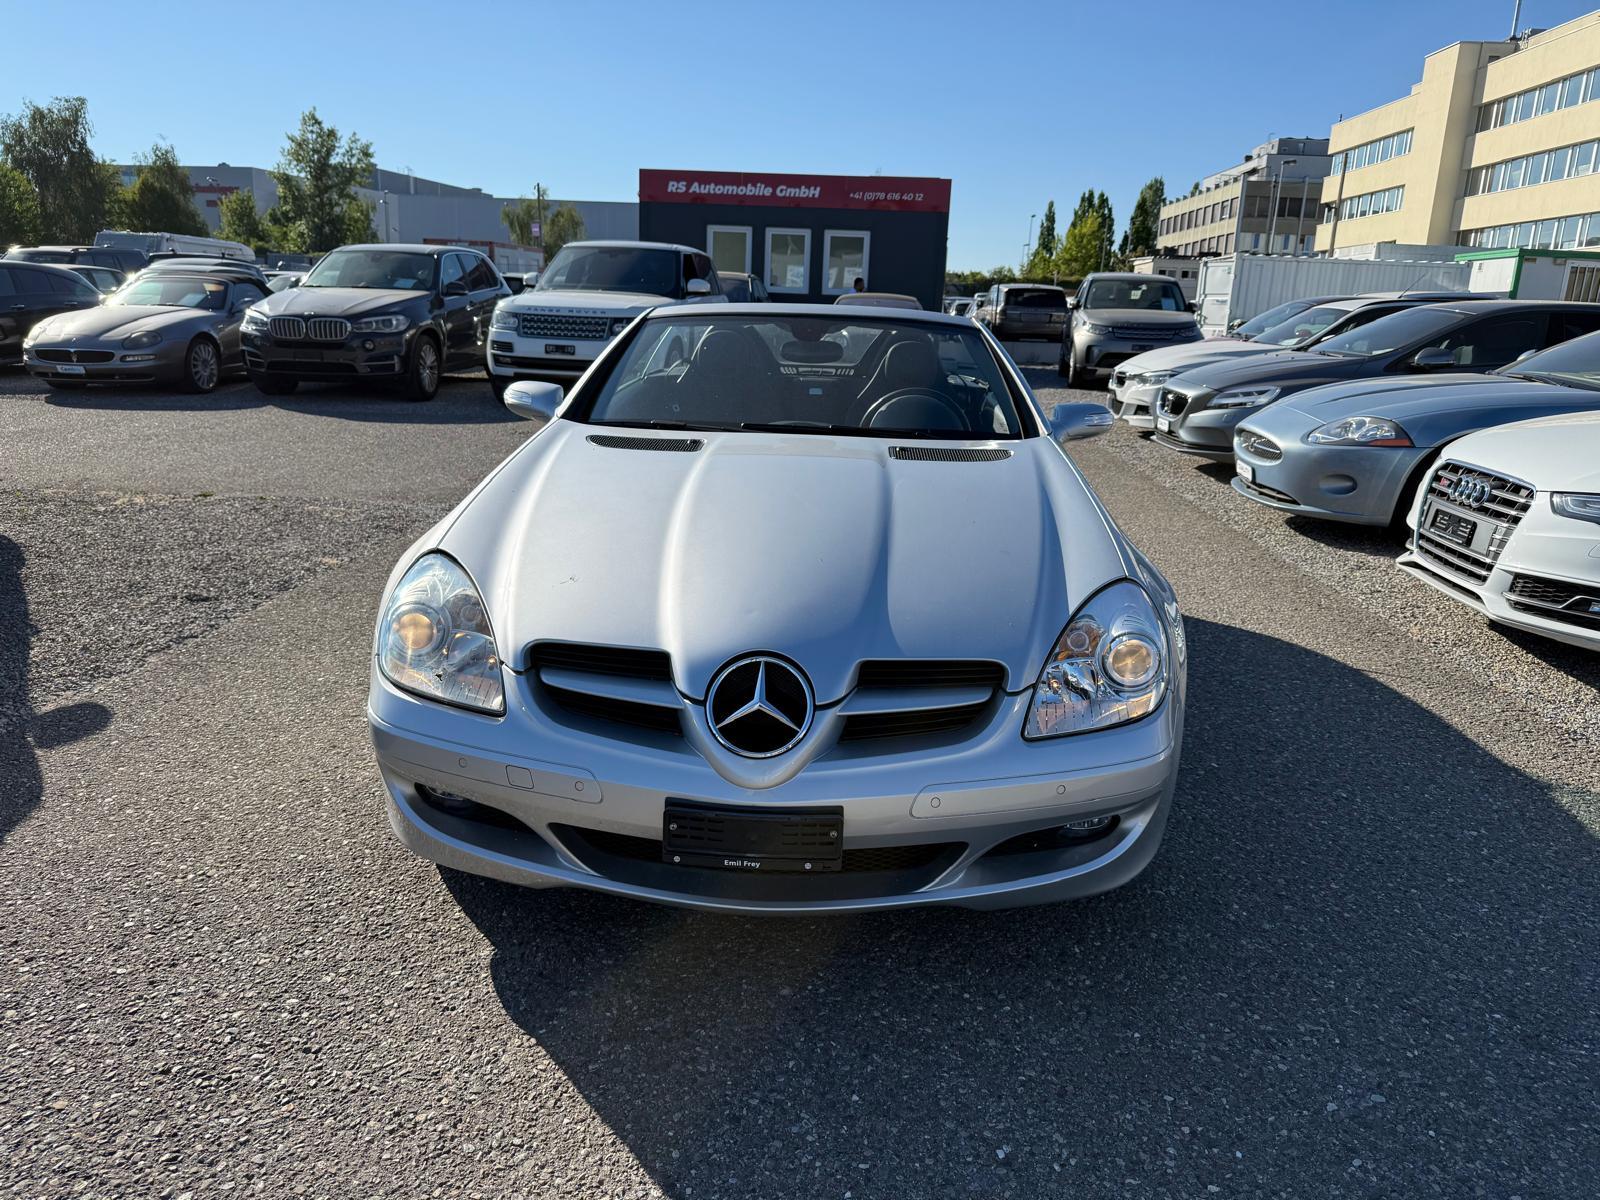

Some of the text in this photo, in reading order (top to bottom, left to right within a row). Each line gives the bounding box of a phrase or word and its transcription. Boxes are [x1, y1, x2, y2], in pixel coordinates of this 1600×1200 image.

[667, 181, 821, 198] RS Automobile GmbH
[849, 191, 924, 201] +41 (0)78 616 40 12
[724, 859, 761, 869] Emil Frey
